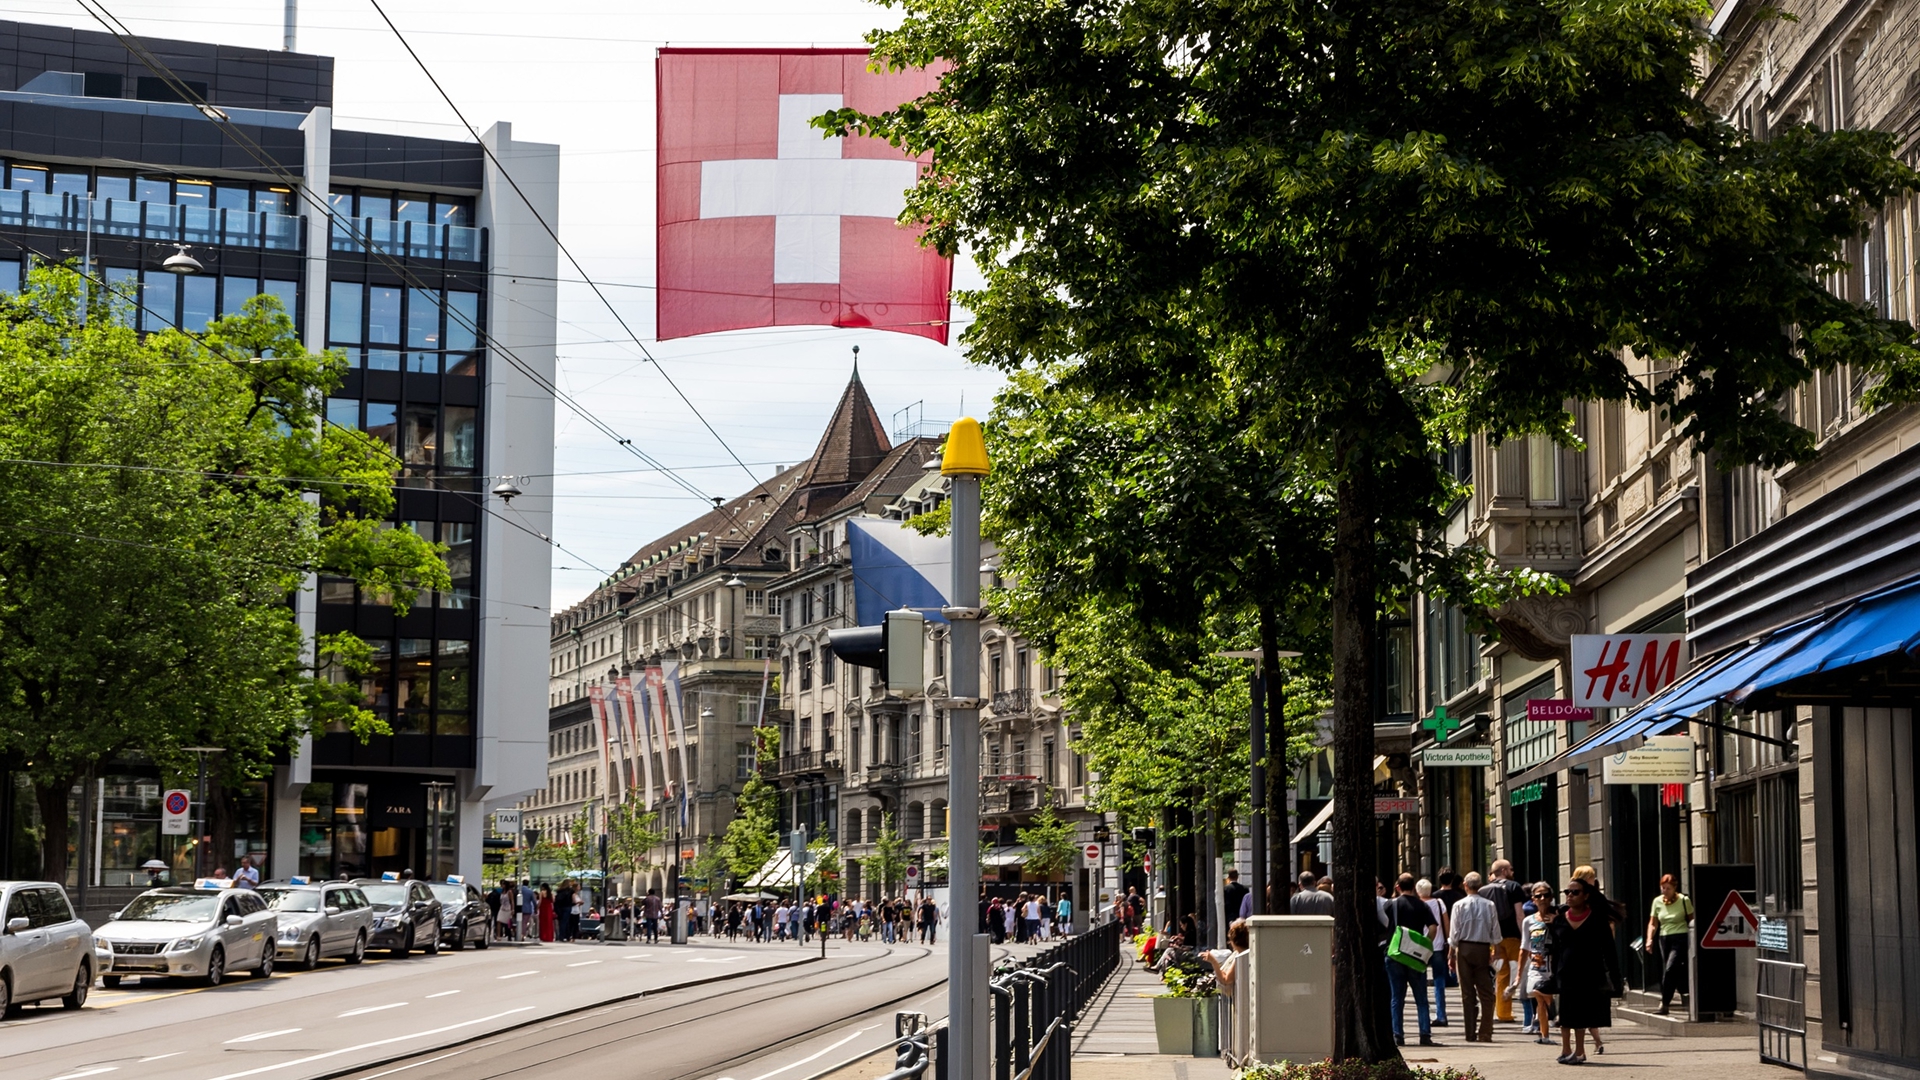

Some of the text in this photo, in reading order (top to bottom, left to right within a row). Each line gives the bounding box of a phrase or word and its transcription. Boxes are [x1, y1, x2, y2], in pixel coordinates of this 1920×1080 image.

[1584, 639, 1681, 702] H&M
[1532, 705, 1591, 715] BELDONA
[1425, 753, 1490, 763] Victoria Apotheke
[386, 805, 412, 814] ZARA
[1374, 800, 1415, 812] ESPRIT
[499, 814, 518, 823] TAXI
